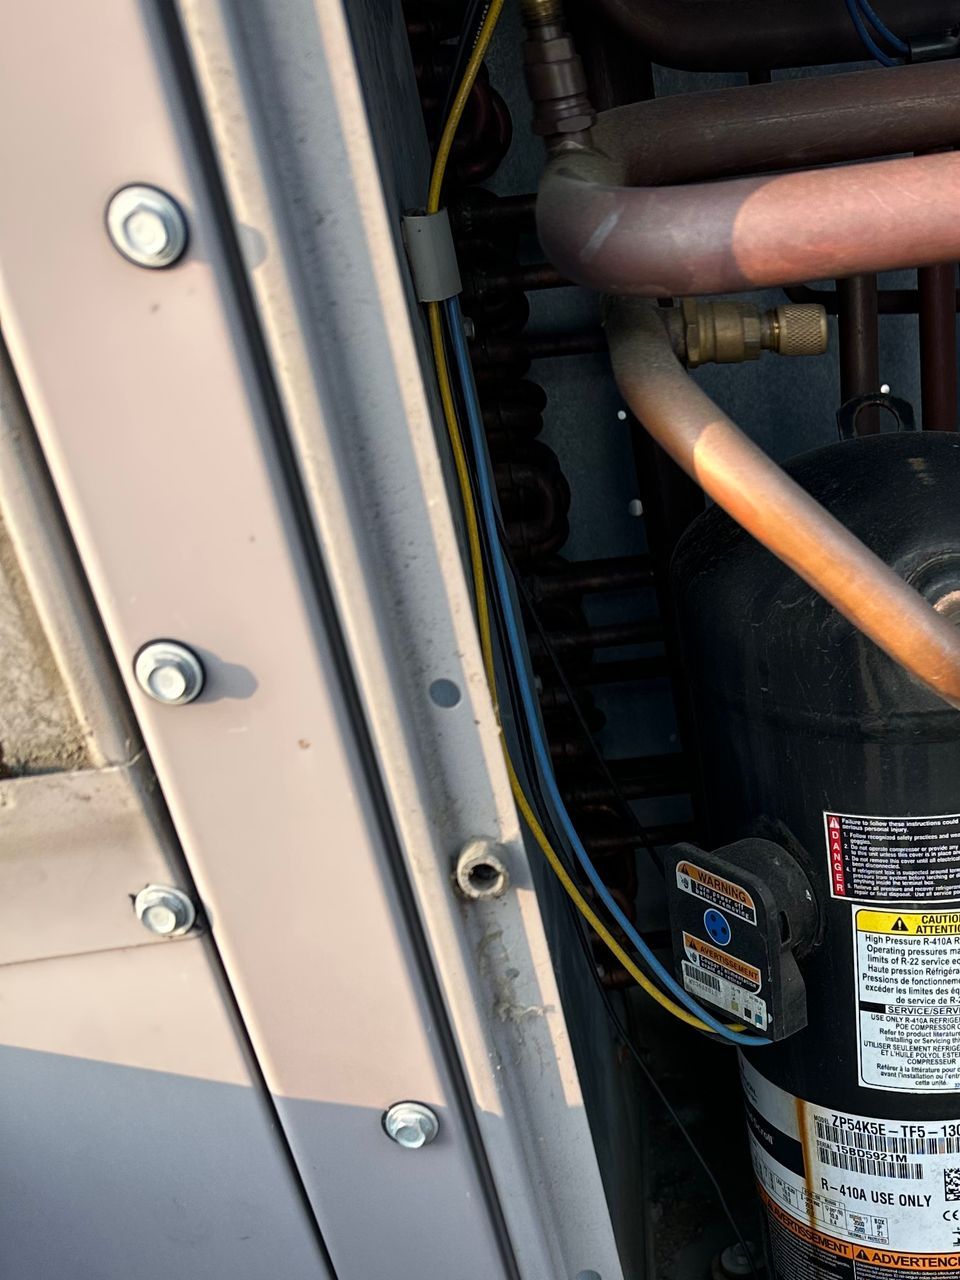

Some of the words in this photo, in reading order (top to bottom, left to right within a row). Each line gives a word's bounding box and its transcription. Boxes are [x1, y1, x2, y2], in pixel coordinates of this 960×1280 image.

[914, 833, 937, 841] practices
[832, 831, 843, 891] DANGER
[698, 872, 746, 902] WARNING
[696, 889, 716, 902] before
[696, 882, 710, 894] Turn
[713, 892, 731, 904] power
[734, 902, 744, 910] off
[865, 934, 883, 944] High
[886, 937, 921, 945] Pressure
[867, 944, 905, 956] Operating
[908, 948, 947, 956] pressures
[700, 946, 758, 978] AVERTISSEMENT
[868, 955, 888, 963] limits
[901, 957, 919, 965] R-22
[868, 964, 889, 973] Haute
[891, 967, 923, 975] pression
[863, 973, 898, 984] Pressions
[866, 985, 894, 993] excéder
[896, 996, 905, 1004] de
[864, 1041, 891, 1049] UTILISER
[893, 1044, 931, 1052] SEULEMENT
[814, 1114, 829, 1125] MODEL
[835, 1144, 907, 1163] 15BD5921M
[871, 1191, 895, 1206] USE
[900, 1194, 932, 1208] ONLY
[943, 1210, 959, 1221] CE
[776, 1209, 848, 1255] AVERTISSEMENT
